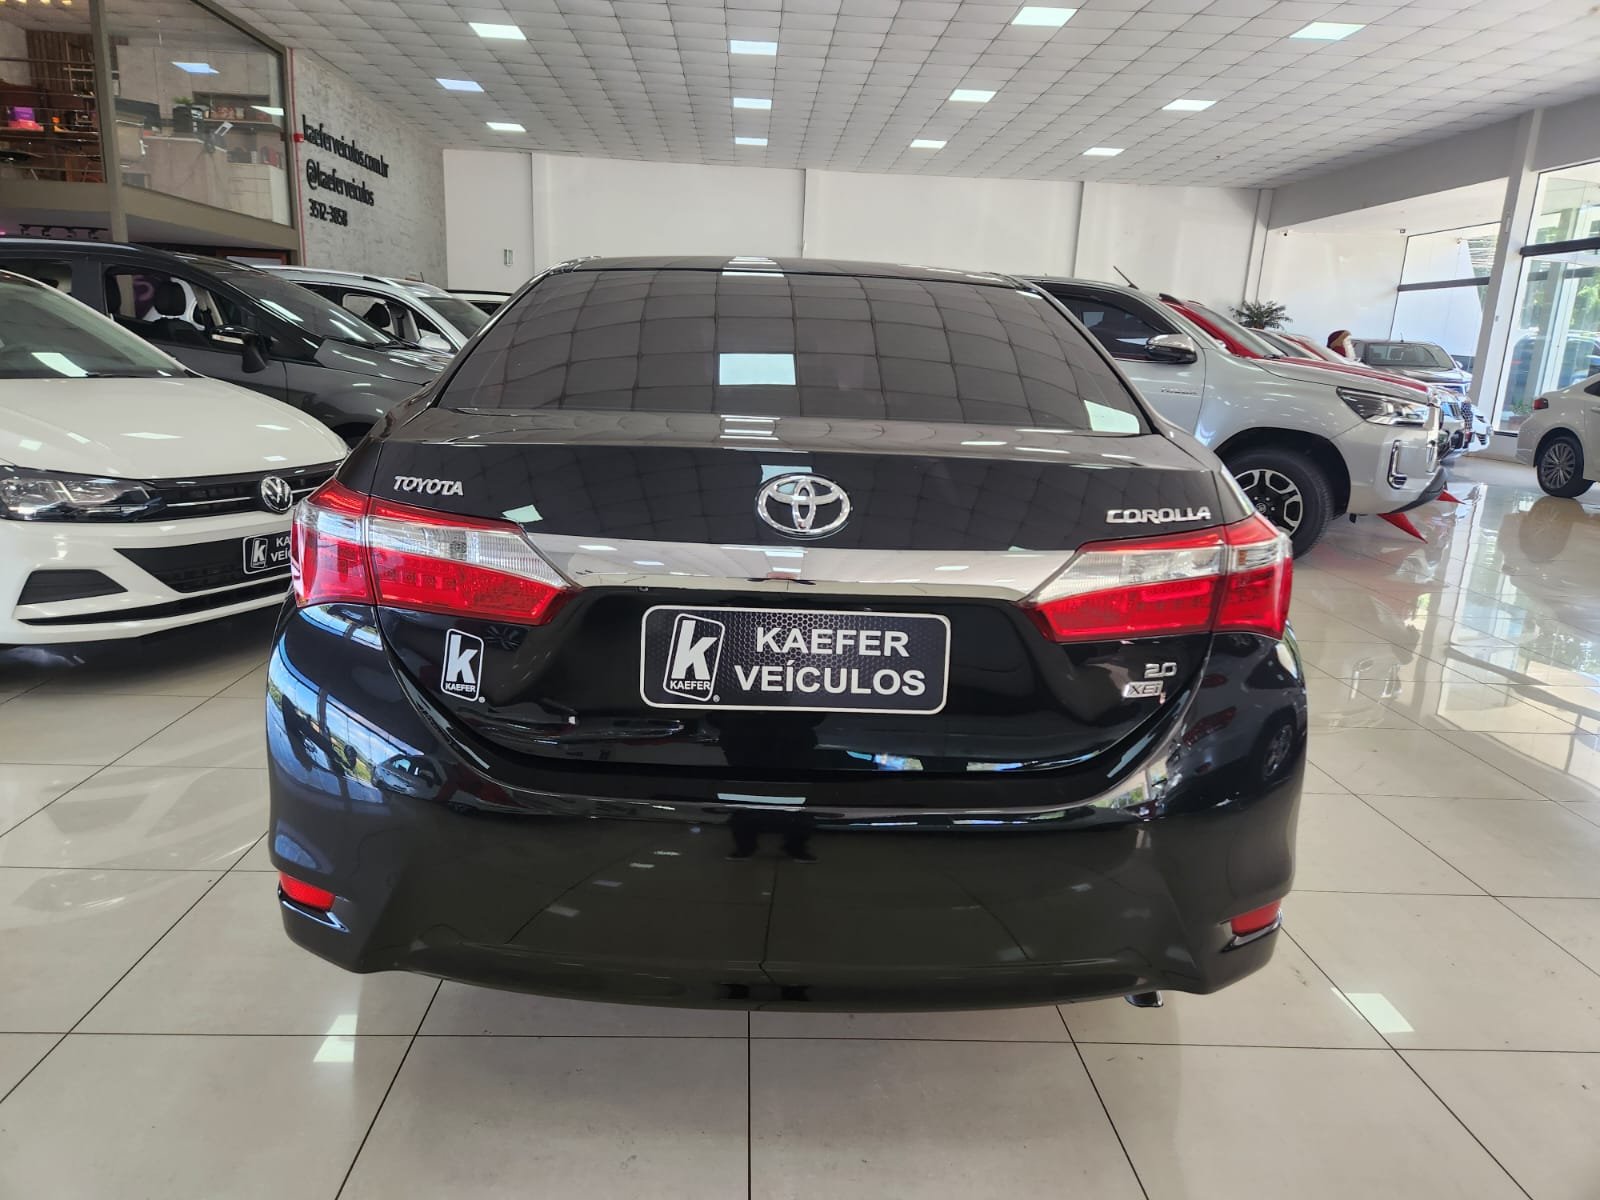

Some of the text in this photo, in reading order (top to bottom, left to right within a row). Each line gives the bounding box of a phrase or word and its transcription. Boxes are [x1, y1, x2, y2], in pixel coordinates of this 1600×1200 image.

[393, 475, 464, 496] TOYOTA
[1105, 506, 1211, 524] COROLLA
[756, 627, 910, 658] KAEFER
[445, 682, 476, 693] KAEFER
[669, 680, 711, 691] KAEFER
[734, 660, 926, 696] VEÍCULOS
